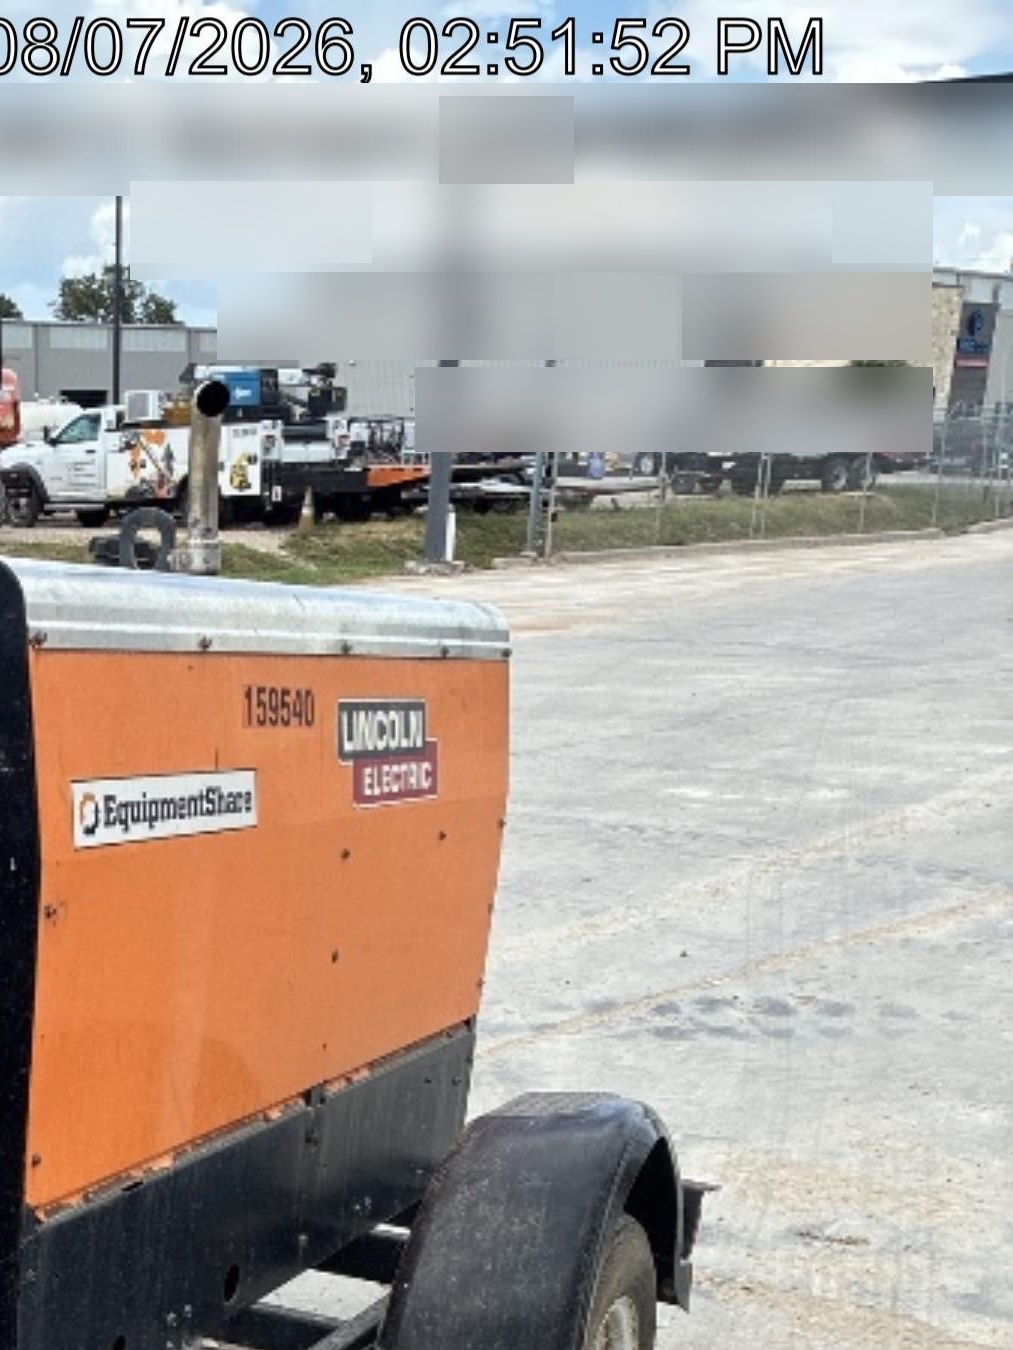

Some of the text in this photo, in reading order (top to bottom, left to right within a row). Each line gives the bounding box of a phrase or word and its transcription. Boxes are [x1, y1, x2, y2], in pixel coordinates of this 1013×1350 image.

[244, 685, 315, 727] 159540
[341, 711, 424, 753] LINCOLN
[363, 762, 432, 796] ELECTRIC
[103, 786, 253, 833] EquipmentShare
